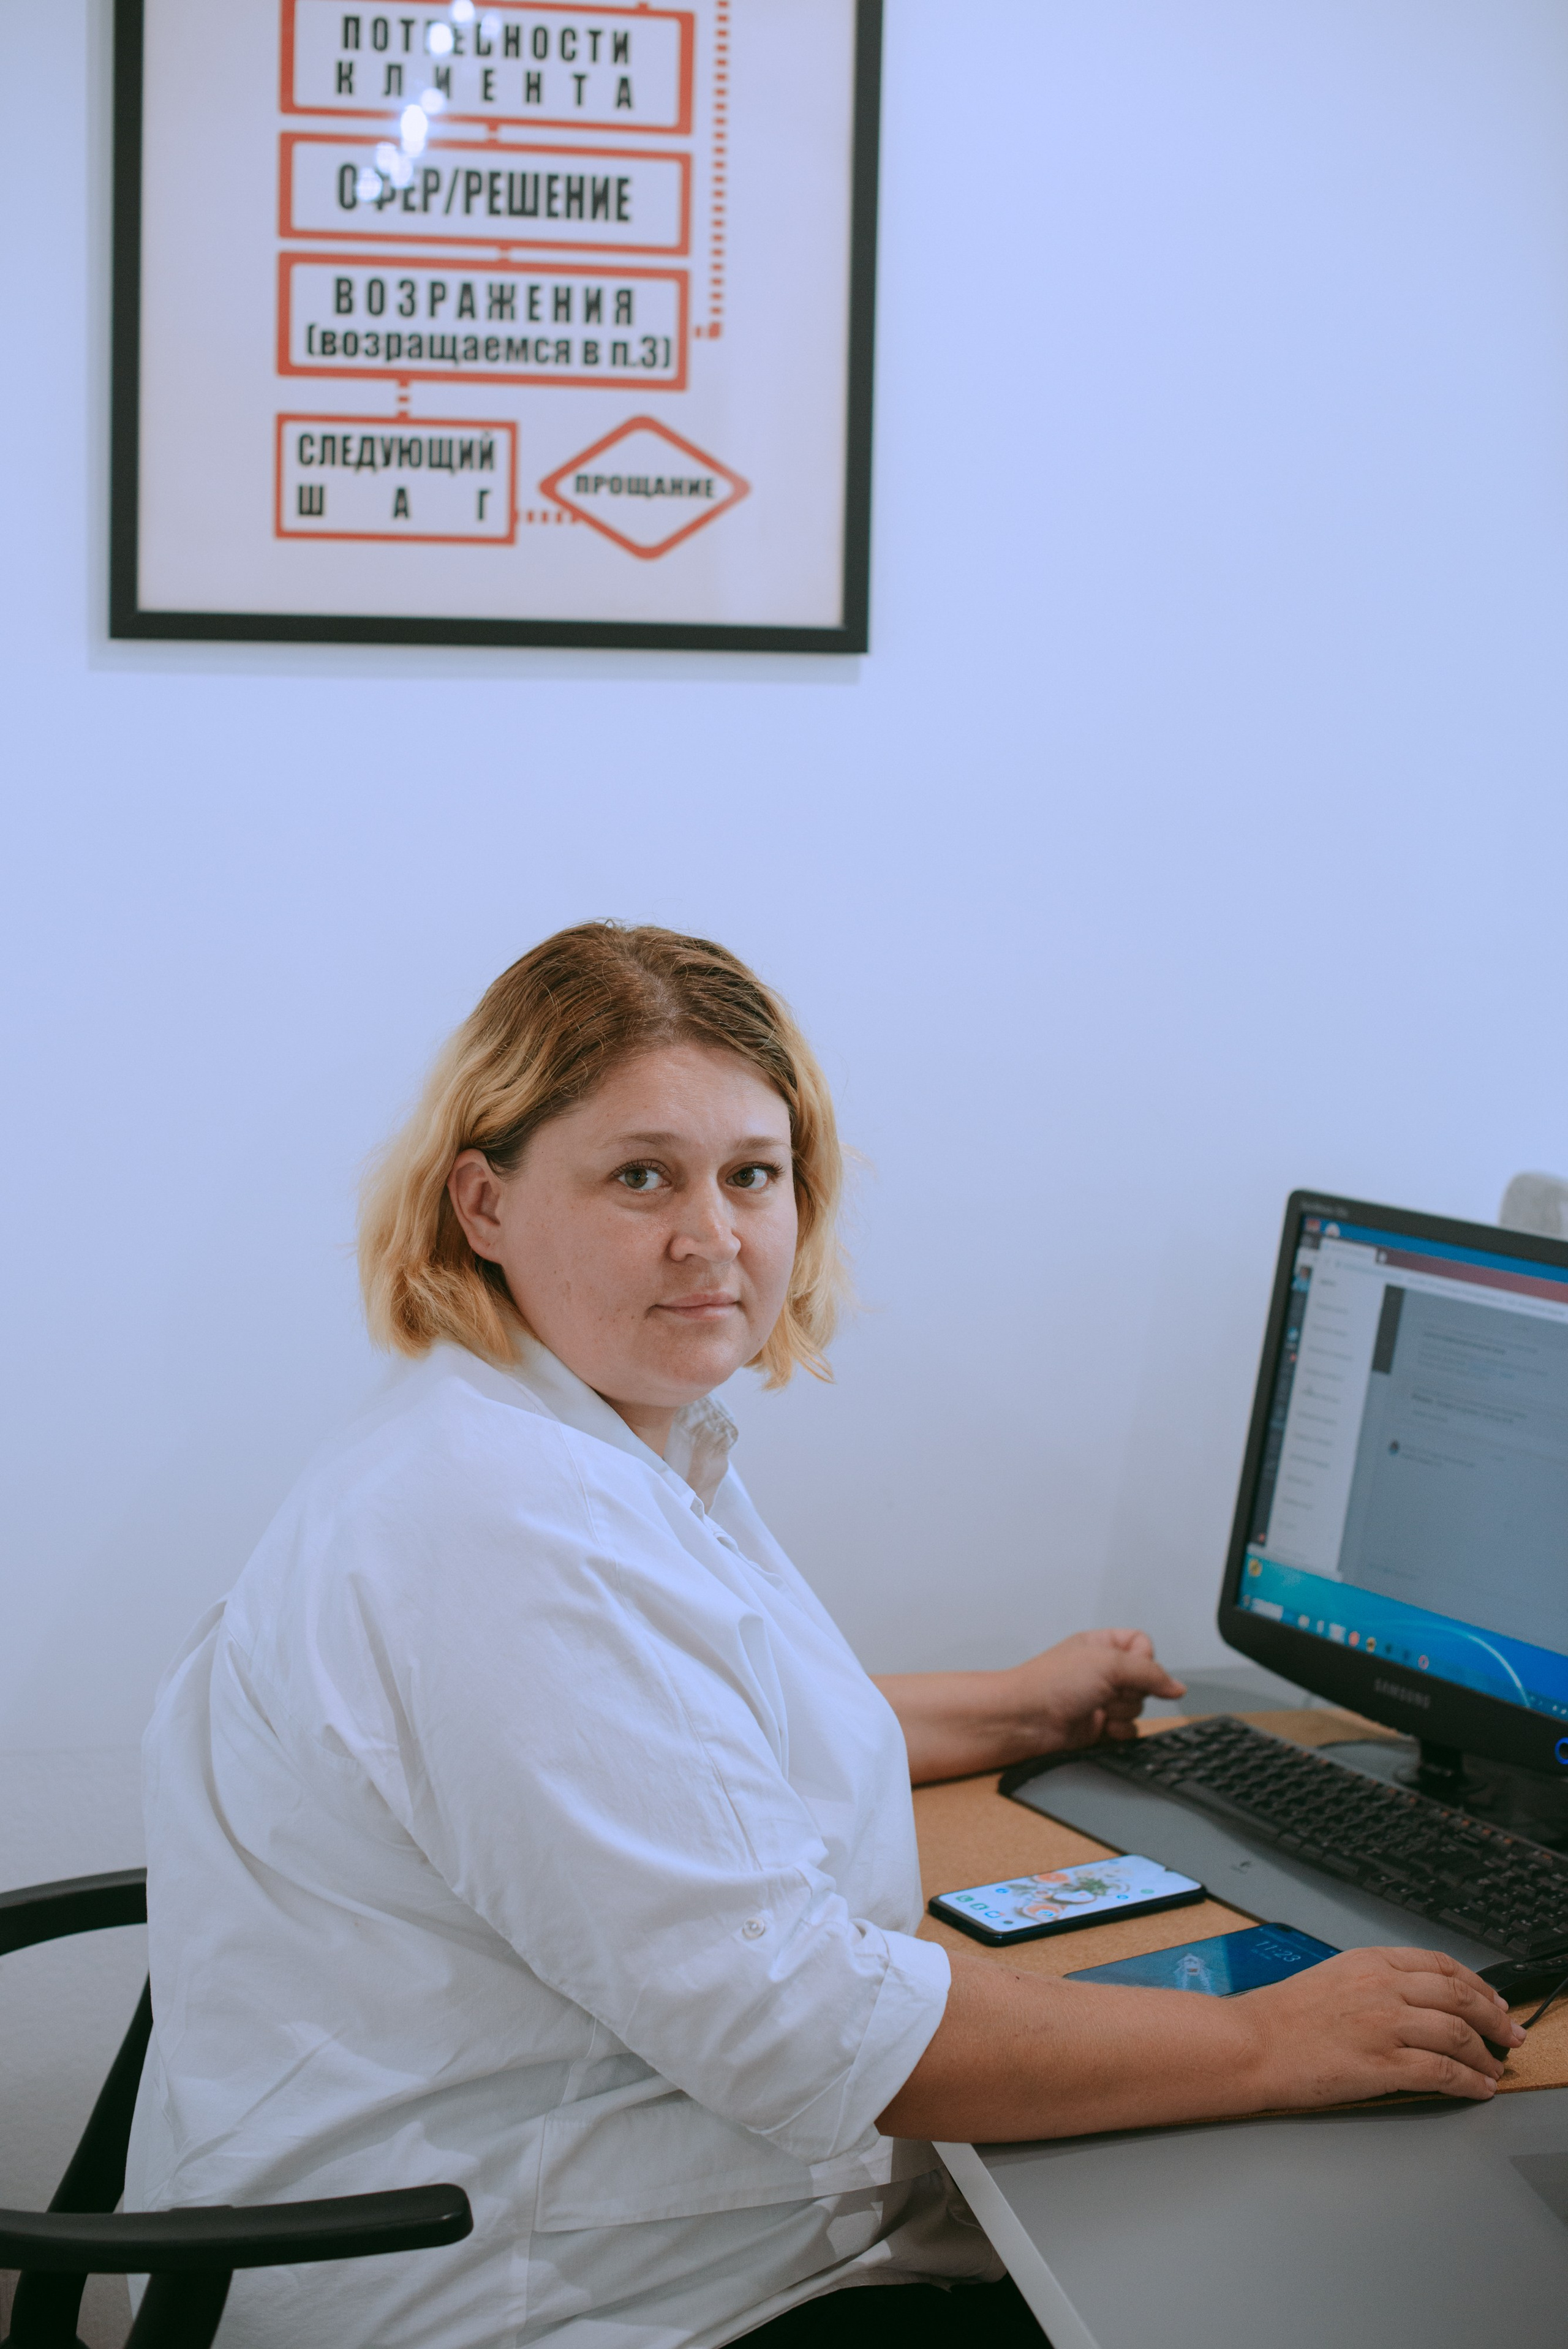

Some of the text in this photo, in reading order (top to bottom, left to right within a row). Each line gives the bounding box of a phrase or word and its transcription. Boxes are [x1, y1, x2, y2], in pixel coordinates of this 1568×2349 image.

[342, 15, 629, 64] ПОТЕБНОСТИ
[336, 61, 633, 109] КЛИЕНТА
[334, 277, 632, 326] ВОЗРАЖЕНИЯ
[306, 323, 671, 370] (возращаемся в п.3)
[299, 431, 494, 476] СЛЕДУЮЩИЙ
[576, 474, 714, 499] ПРОЩАНИЕ
[1256, 1940, 1302, 1962] 11:23
